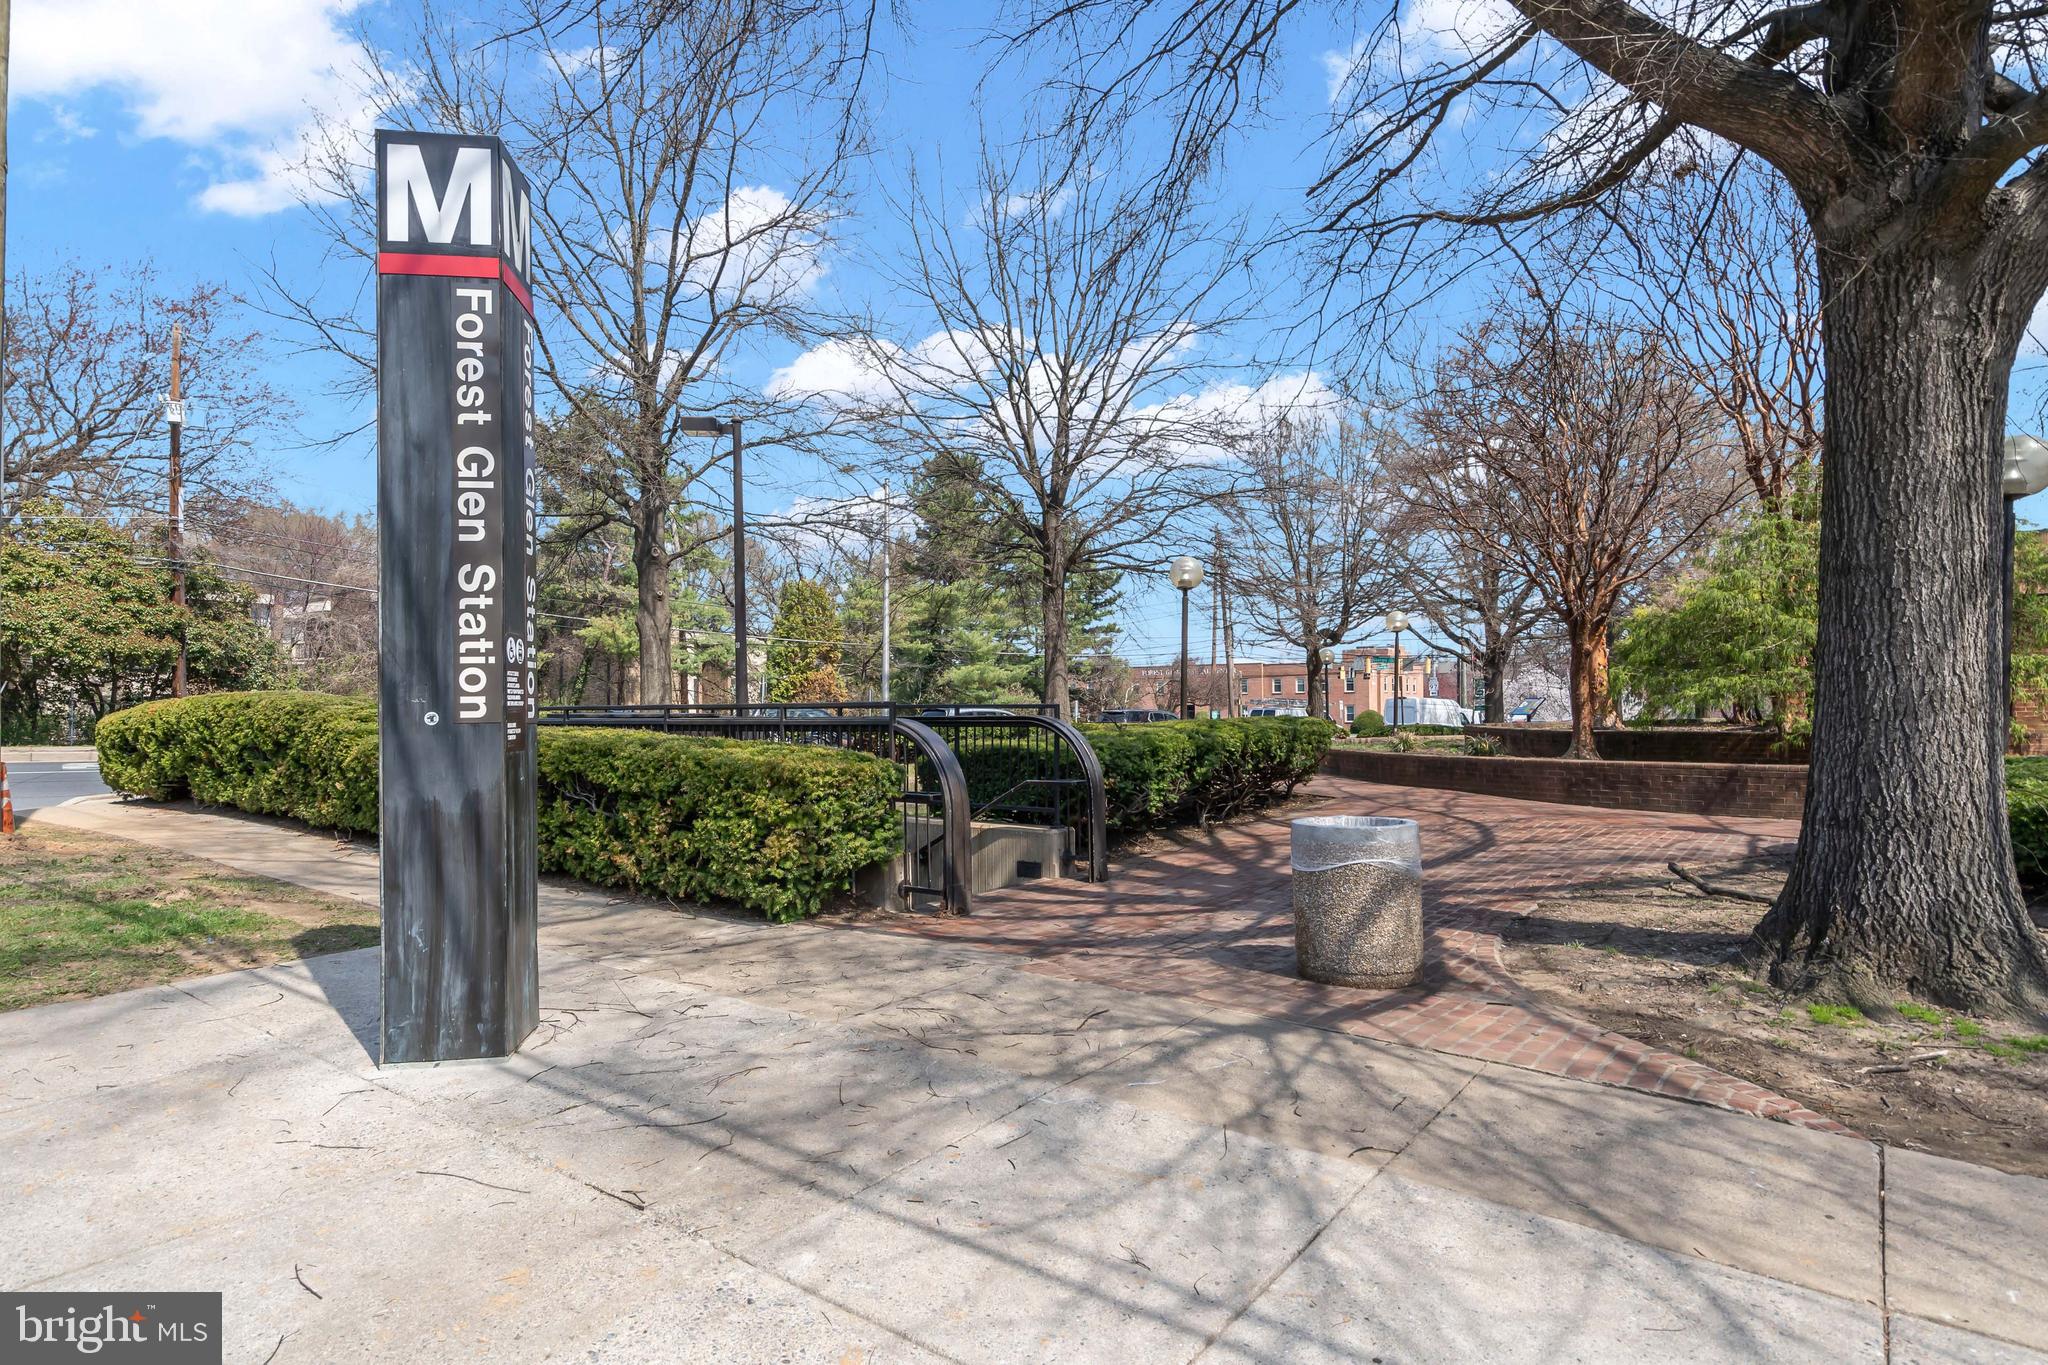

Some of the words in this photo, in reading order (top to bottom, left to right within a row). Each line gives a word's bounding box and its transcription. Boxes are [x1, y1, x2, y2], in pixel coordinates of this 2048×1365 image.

[387, 143, 492, 245] M
[502, 158, 531, 286] M
[456, 288, 493, 425] Forest
[524, 319, 535, 448] Forest
[457, 446, 495, 542] Glen
[525, 467, 536, 557] Glen
[458, 563, 496, 719] Station
[527, 575, 537, 719] Station
